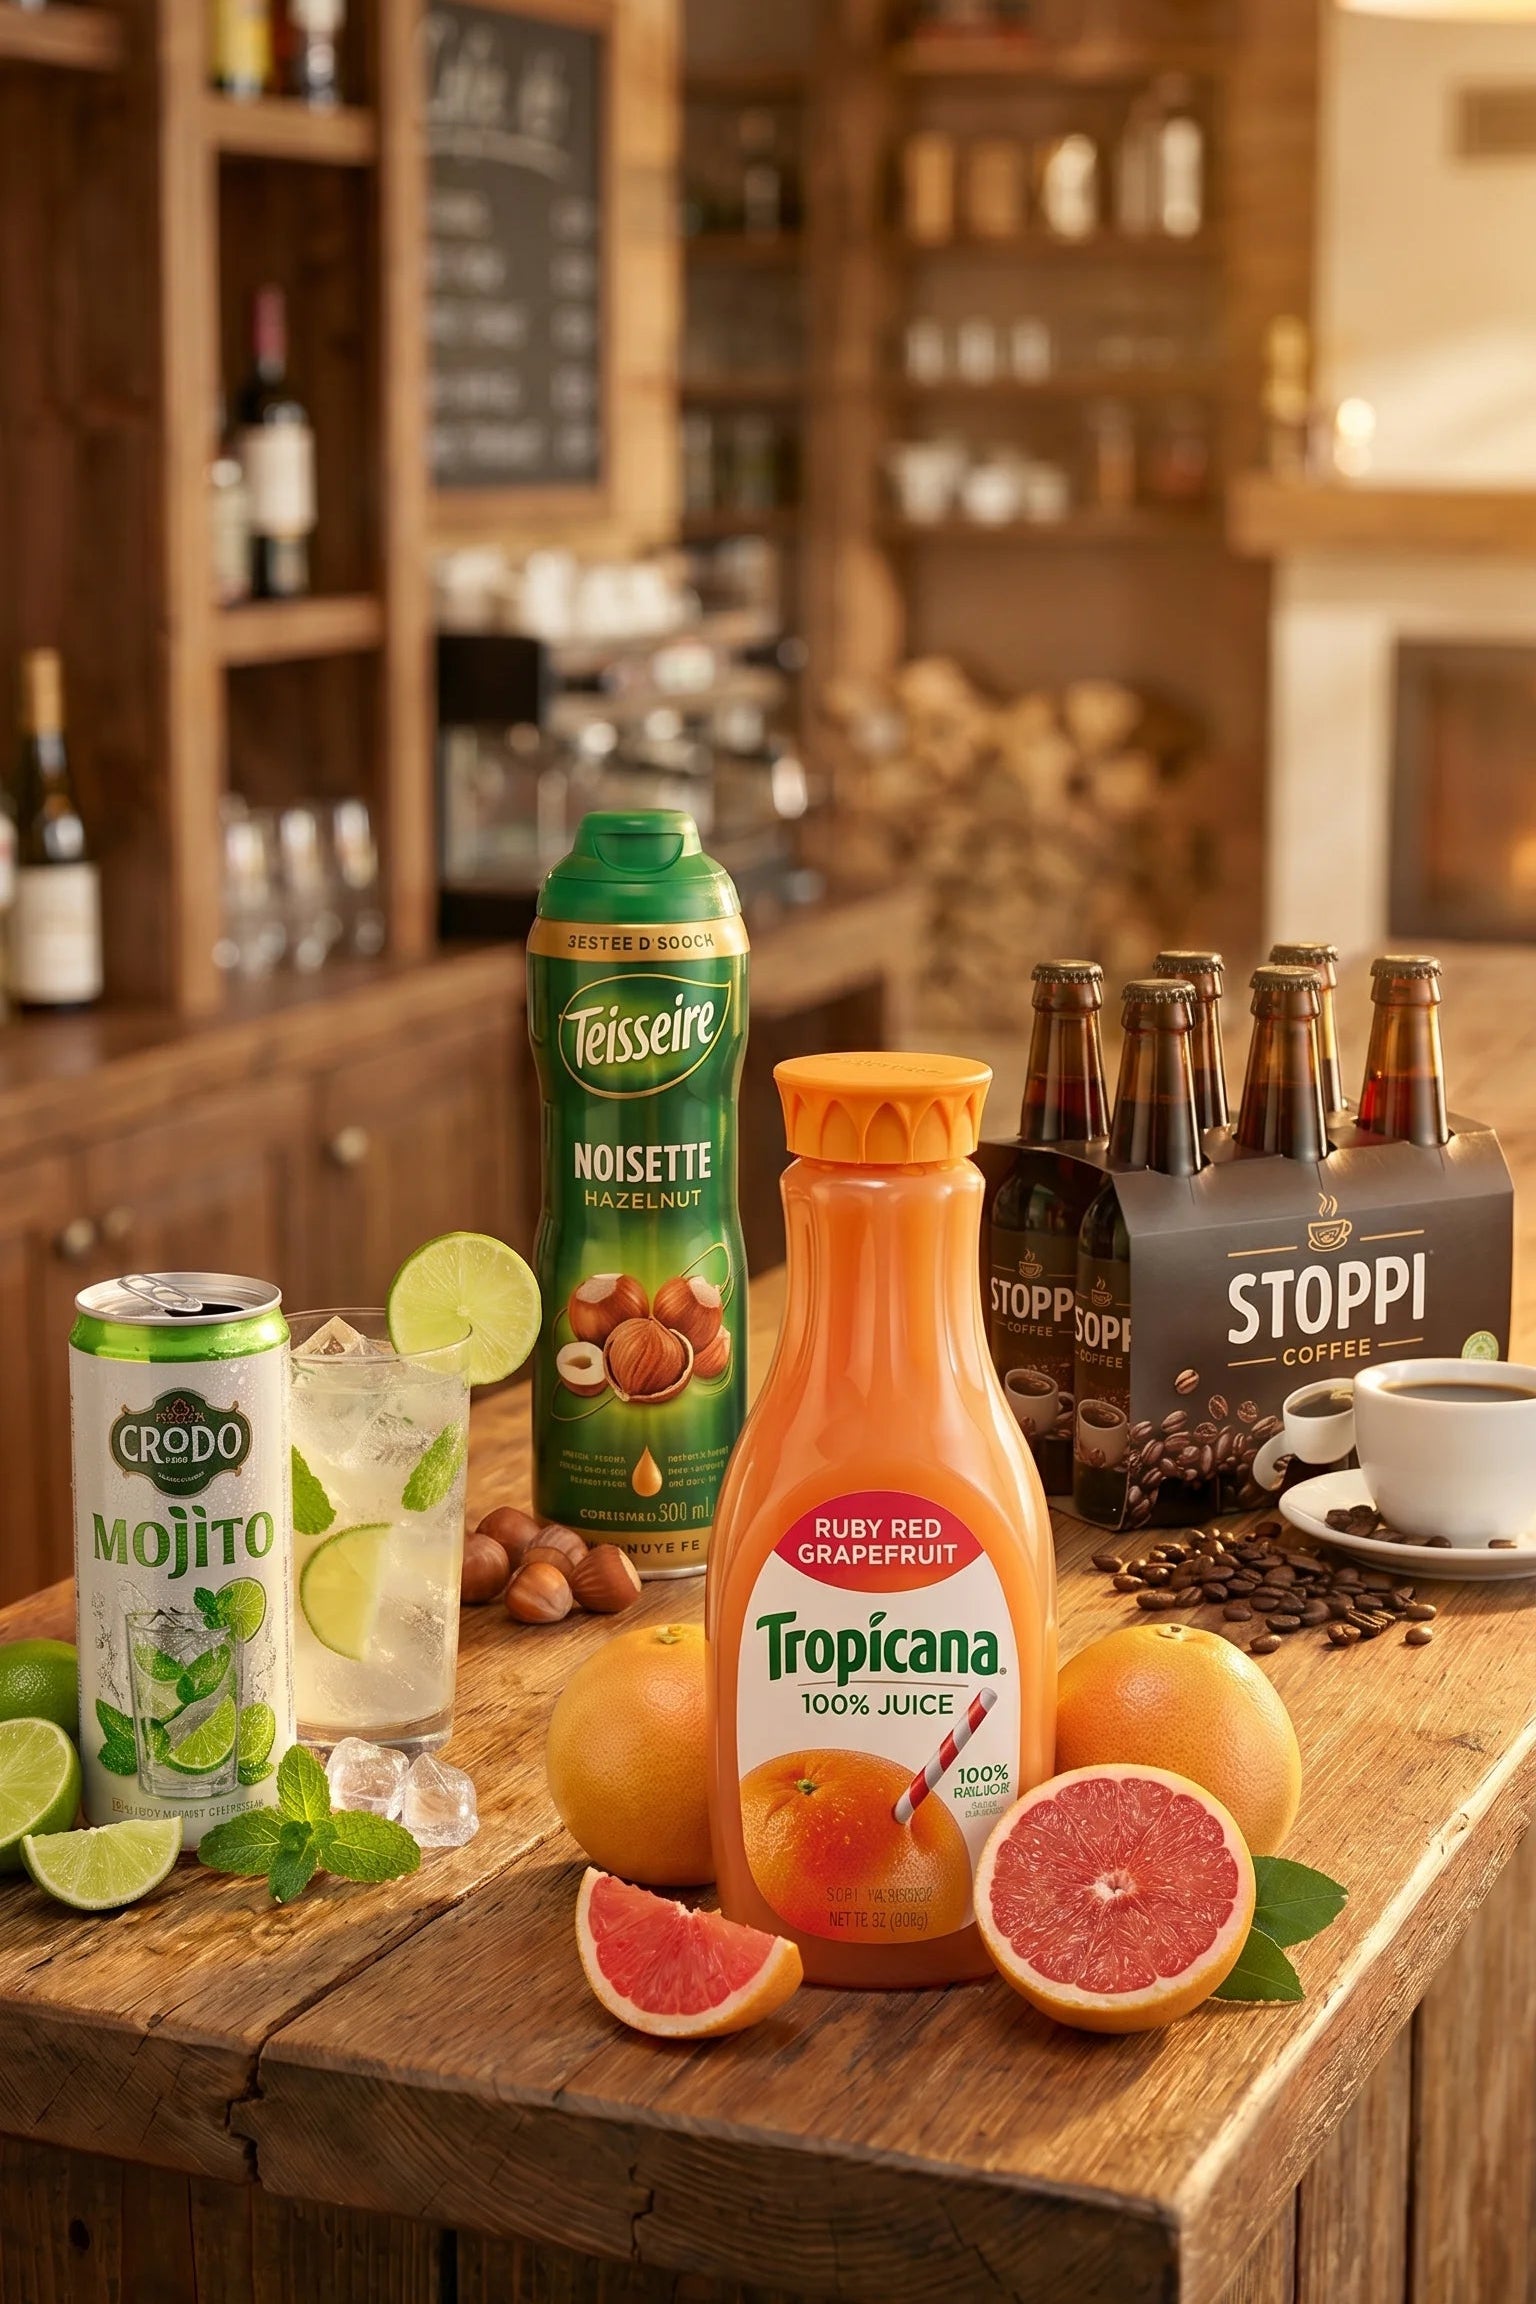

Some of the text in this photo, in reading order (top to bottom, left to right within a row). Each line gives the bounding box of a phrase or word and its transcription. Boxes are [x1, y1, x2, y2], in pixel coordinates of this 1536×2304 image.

[564, 992, 715, 1070] Teisseire
[574, 1141, 712, 1183] NOISETTE
[584, 1188, 702, 1210] HAZELNUT
[1228, 1252, 1426, 1345] STOPPI
[1007, 1321, 1053, 1337] COFFEE
[1080, 1349, 1123, 1369] COFFEE
[1282, 1338, 1371, 1366] COFFEE
[119, 1422, 243, 1464] CRODO
[815, 1518, 942, 1539] RUBY RED
[798, 1543, 958, 1565] GRAPEFRUIT
[756, 1611, 999, 1688] Tropicana
[801, 1693, 954, 1716] 100% JUICE
[957, 1763, 1009, 1785] 100%
